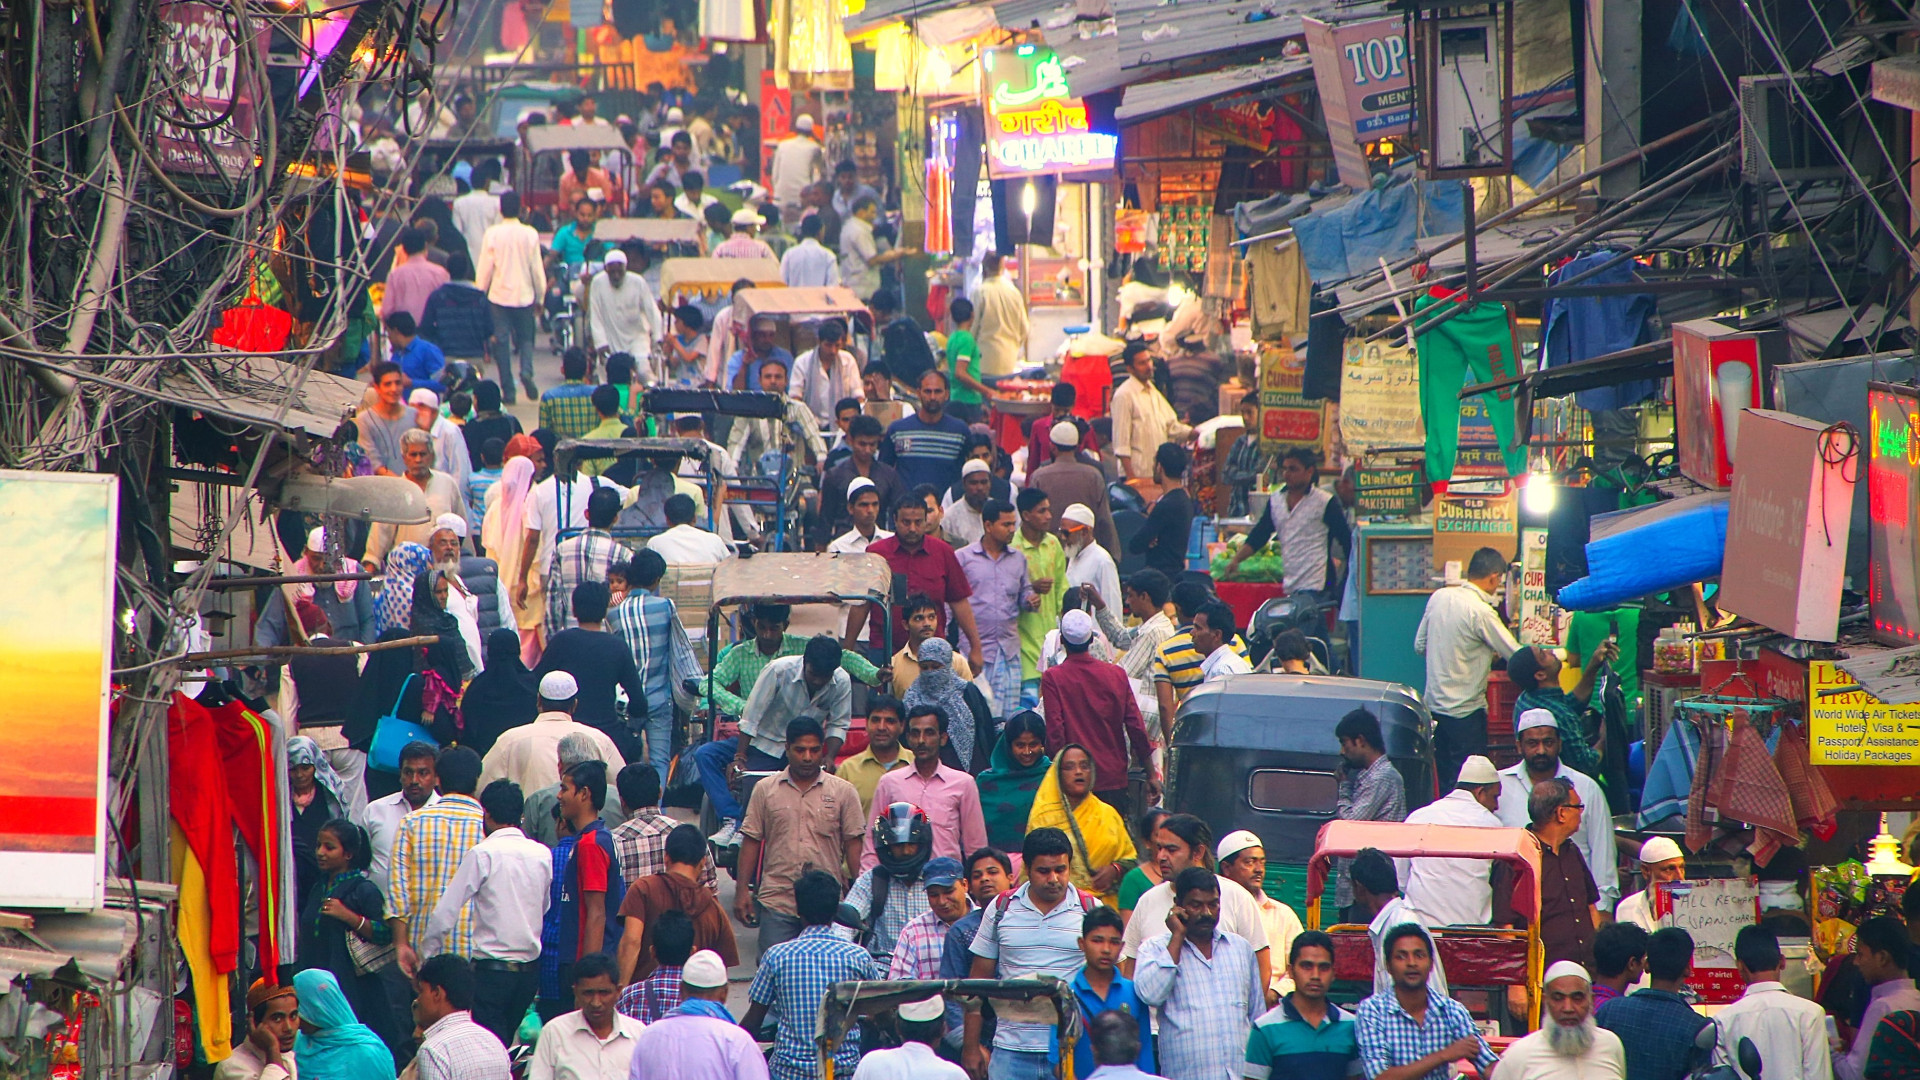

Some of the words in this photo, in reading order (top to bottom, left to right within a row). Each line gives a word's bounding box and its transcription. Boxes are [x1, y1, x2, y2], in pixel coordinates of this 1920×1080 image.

[1345, 35, 1408, 85] TOP
[1464, 499, 1484, 508] OLD
[1439, 501, 1510, 520] CURRENCY
[1437, 519, 1513, 532] EXCHANGER
[1814, 709, 1843, 719] World
[1845, 709, 1870, 719] Wide
[1873, 709, 1887, 719] Air
[1873, 723, 1894, 733] Visa
[1897, 723, 1904, 733] &
[1867, 736, 1919, 747] Assistance
[1825, 750, 1861, 762] Holiday
[1864, 750, 1912, 763] Packages
[1680, 895, 1708, 909] ALL
[1714, 970, 1733, 979] airtel
